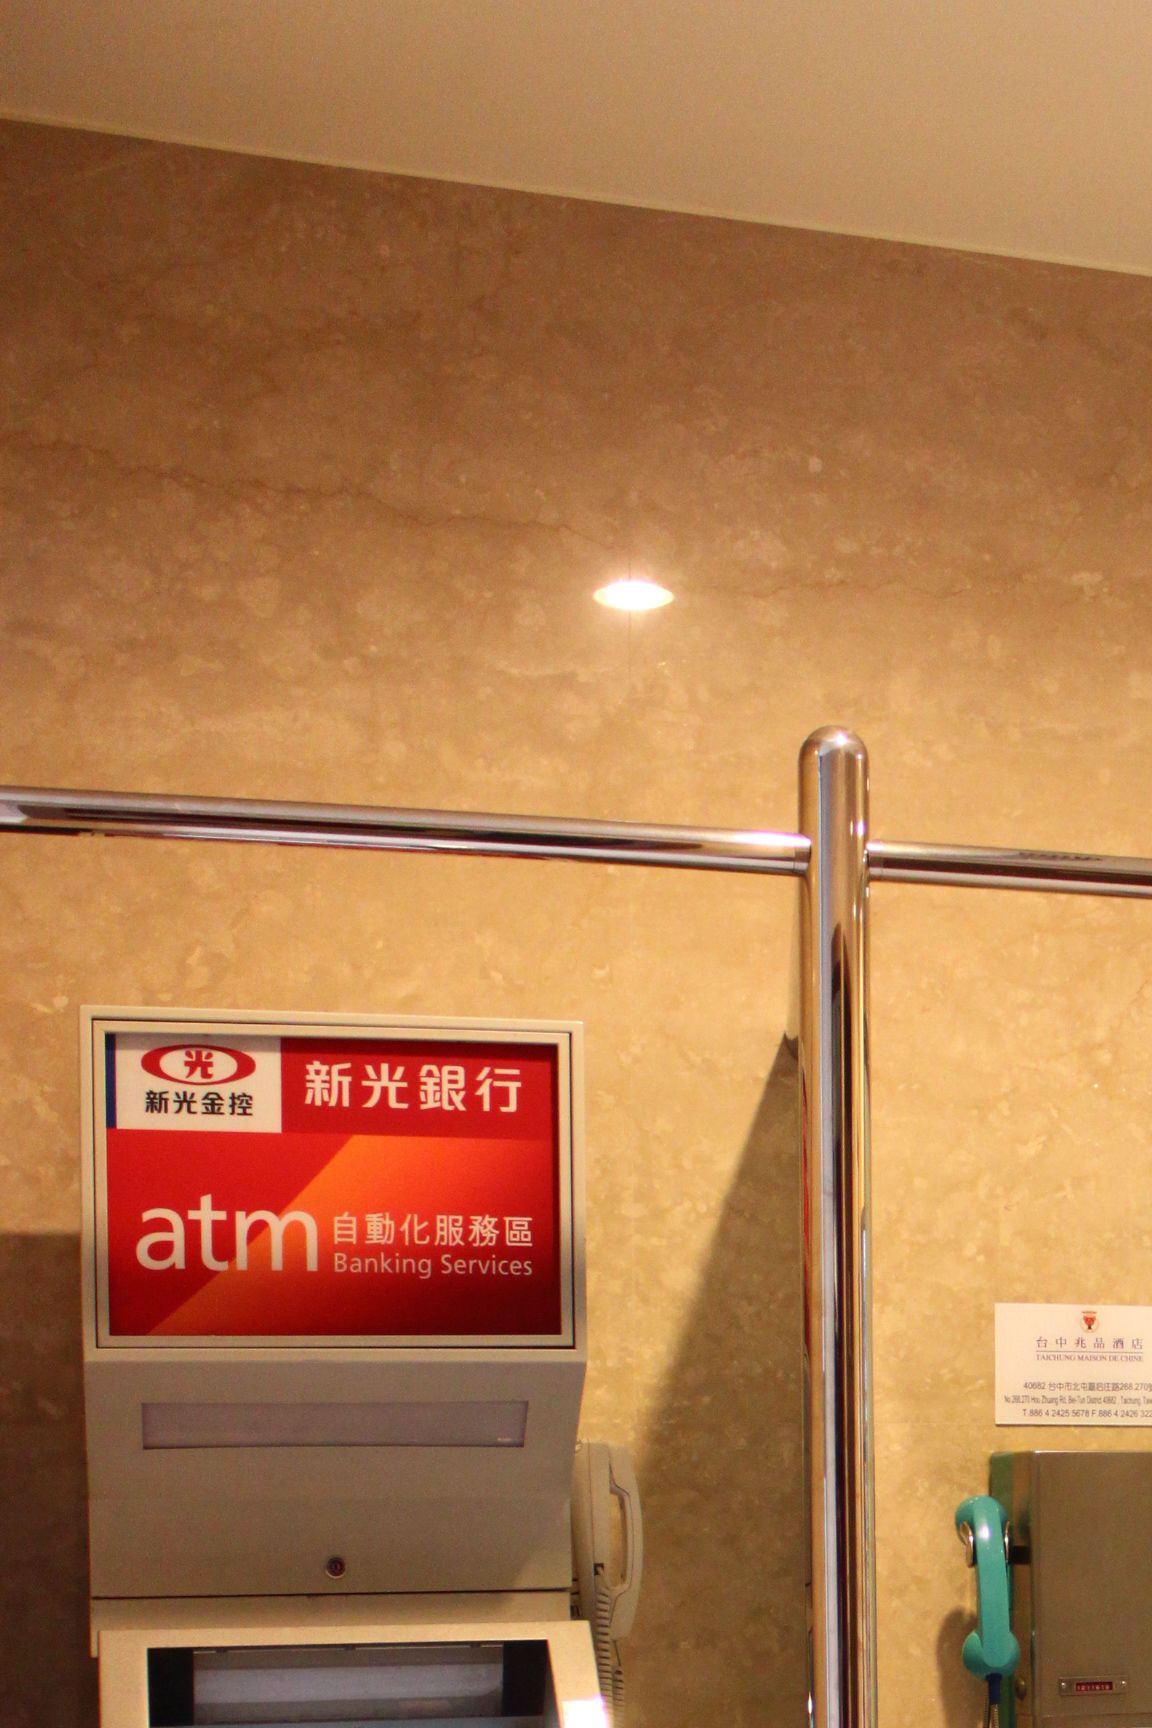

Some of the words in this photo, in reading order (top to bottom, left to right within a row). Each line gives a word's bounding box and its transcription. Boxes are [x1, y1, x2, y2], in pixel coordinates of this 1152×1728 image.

[304, 1060, 522, 1114] 新光銀行
[145, 1089, 254, 1117] 新光金控
[135, 1194, 318, 1272] atm
[333, 1211, 533, 1248] 自動化服務區
[333, 1252, 433, 1280] Banking
[441, 1253, 533, 1278] Services
[1035, 1336, 1144, 1350] 台中兆品酒店
[1036, 1353, 1076, 1362] TAICHUNG
[1077, 1354, 1108, 1362] MAISON
[1120, 1355, 1144, 1363] CHINE
